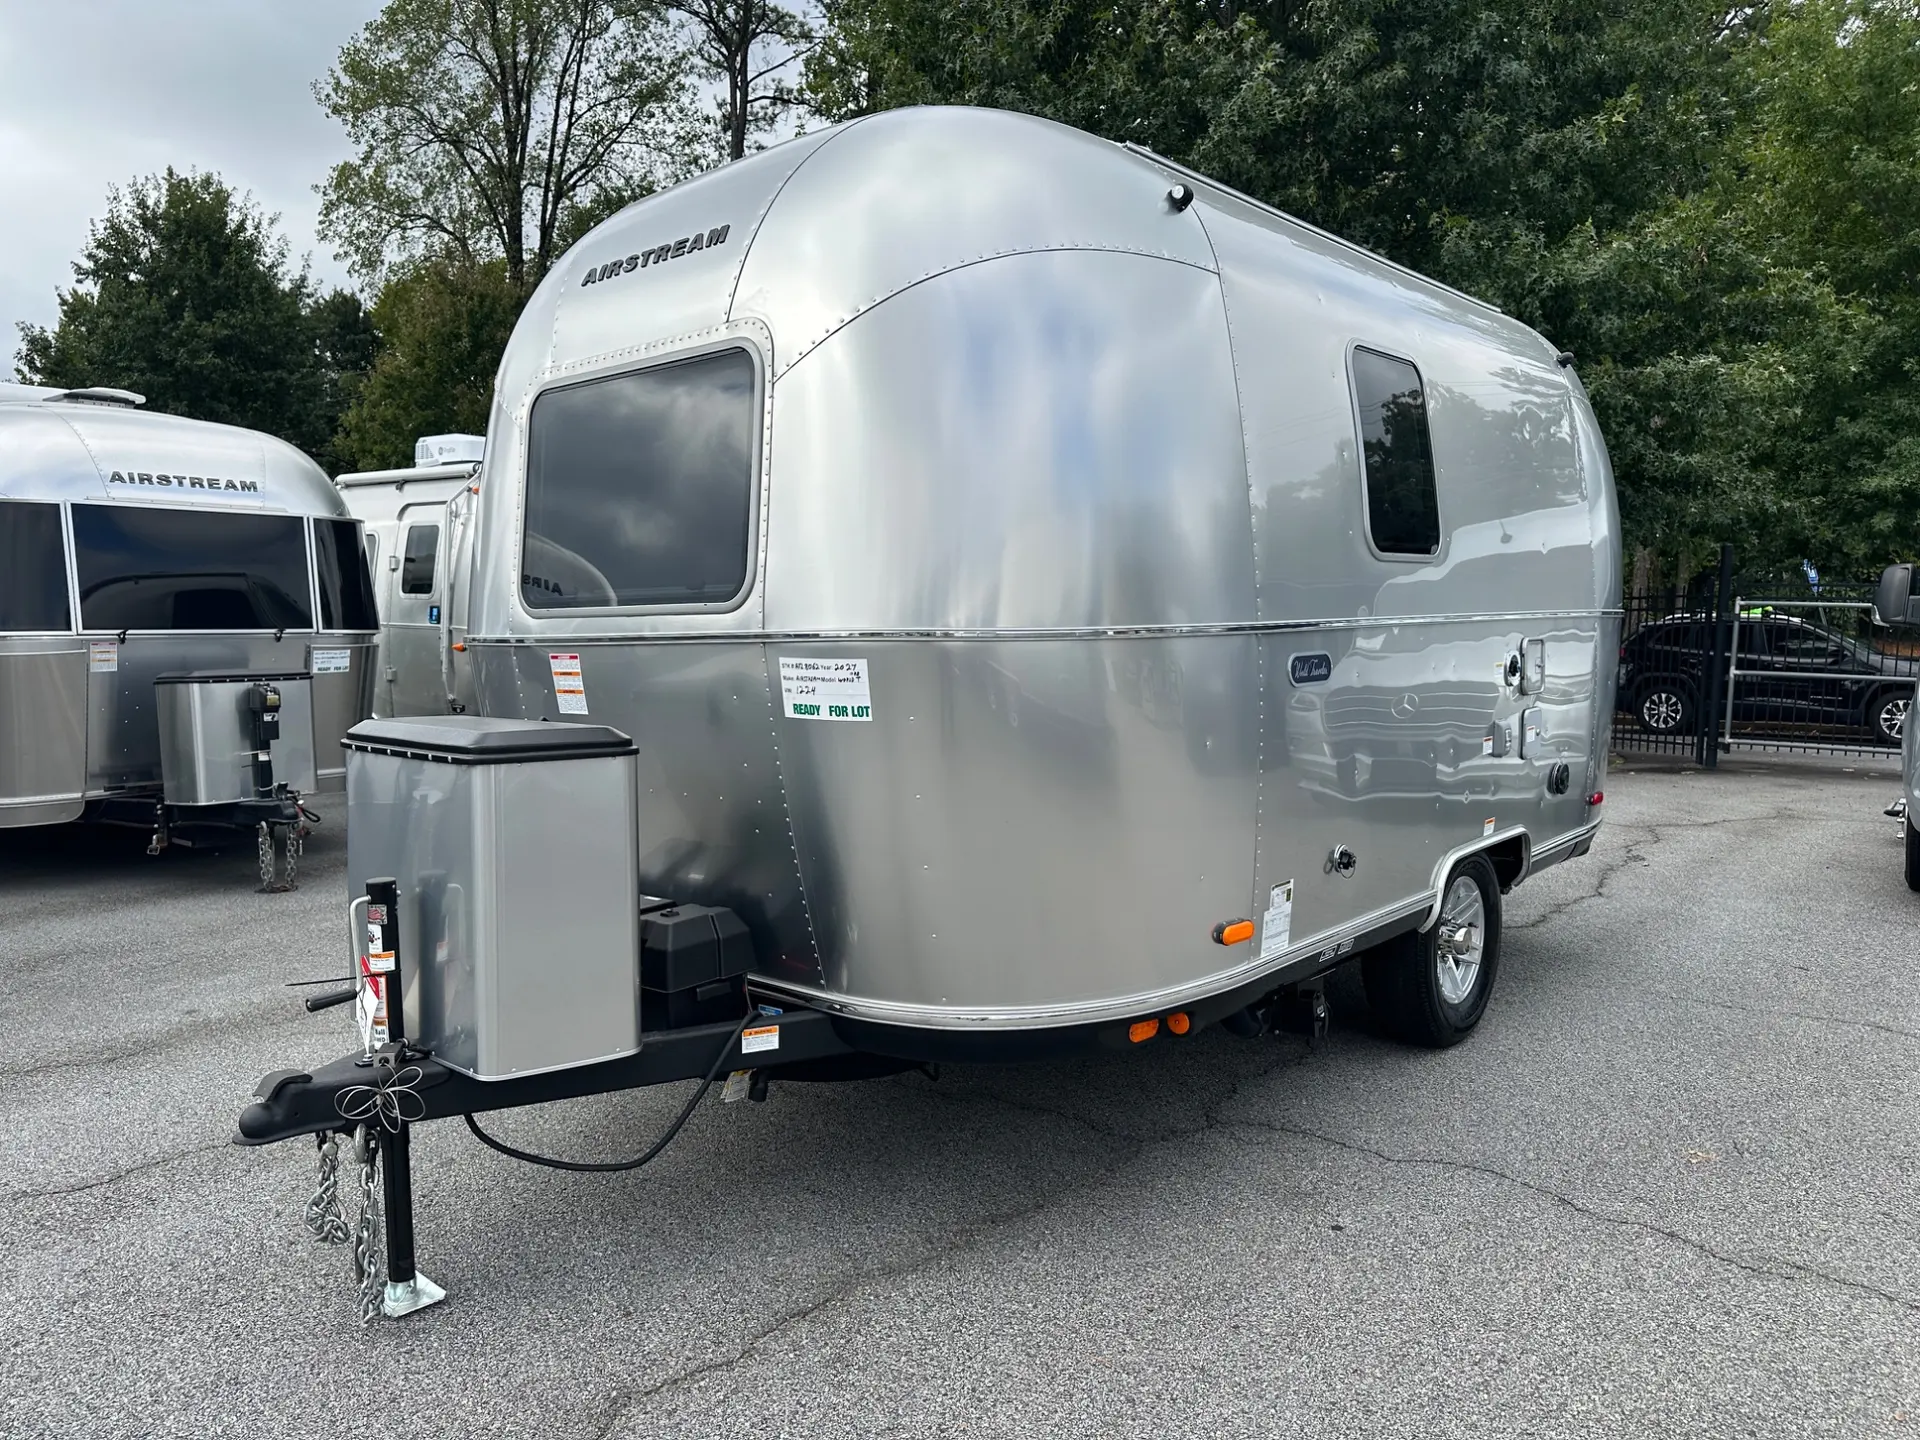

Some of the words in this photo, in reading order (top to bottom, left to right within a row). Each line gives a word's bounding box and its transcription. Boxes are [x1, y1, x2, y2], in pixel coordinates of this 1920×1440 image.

[581, 224, 730, 287] AIRSTREAM
[109, 470, 258, 492] AIRSTREAM
[793, 703, 820, 716] READY
[828, 705, 848, 717] FOR
[851, 706, 870, 717] LOT
